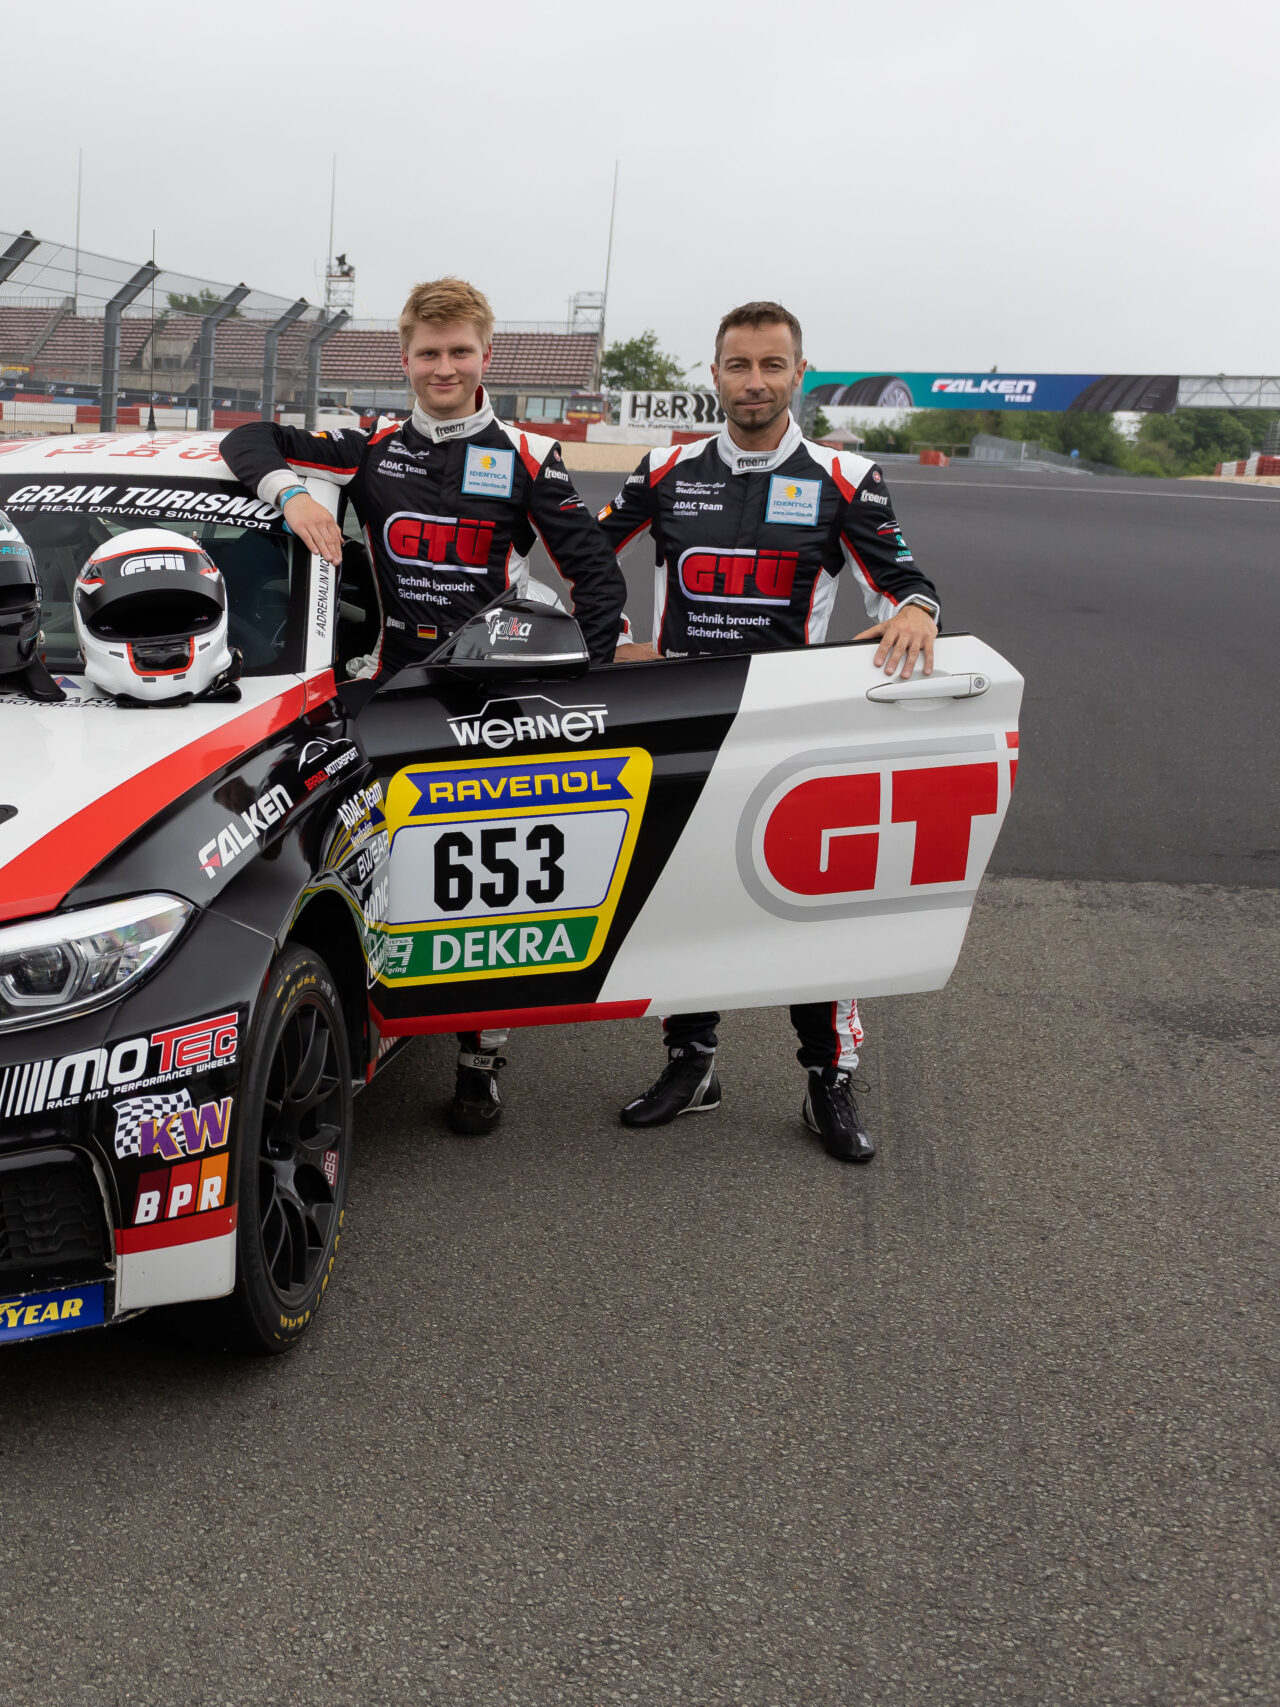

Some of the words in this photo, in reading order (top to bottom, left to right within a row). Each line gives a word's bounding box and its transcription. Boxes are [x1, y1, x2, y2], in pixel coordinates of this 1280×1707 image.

[931, 378, 1037, 394] FALKEN
[630, 394, 688, 419] H&R
[434, 422, 465, 438] freem
[379, 459, 404, 472] ADAC
[404, 463, 428, 475] Team
[469, 470, 507, 480] IDENTICA
[544, 467, 569, 482] freem
[736, 456, 771, 469] freem
[7, 485, 118, 504] GRAN
[118, 486, 284, 521] TURISMO
[673, 501, 697, 510] ADAC
[698, 502, 723, 511] Team
[773, 500, 813, 509] IDENTICA
[860, 489, 888, 506] freem
[3, 504, 28, 512] THE
[31, 505, 84, 513] REAL
[88, 505, 161, 517] DRIVING
[164, 510, 272, 531] SIMULATOR
[388, 518, 496, 565] GTÜ
[396, 573, 431, 588] Technik
[682, 550, 799, 597] GTÜ
[687, 611, 725, 625] Technik
[726, 614, 771, 626] braucht
[686, 626, 744, 640] Sicherheit.
[323, 746, 359, 777] MOTORSPORT
[428, 770, 612, 804] RAVENOL
[336, 794, 366, 831] ADAC
[358, 781, 383, 811] Team
[198, 784, 294, 879] FALKEN
[433, 824, 565, 913] 653
[432, 923, 576, 972] DEKRA
[46, 1096, 80, 1110] RACE
[84, 1088, 109, 1101] AND
[113, 1067, 192, 1095] PERFORMANCE
[196, 1055, 237, 1072] WHEELS
[138, 1097, 233, 1161] KW
[134, 1175, 222, 1225] BPR
